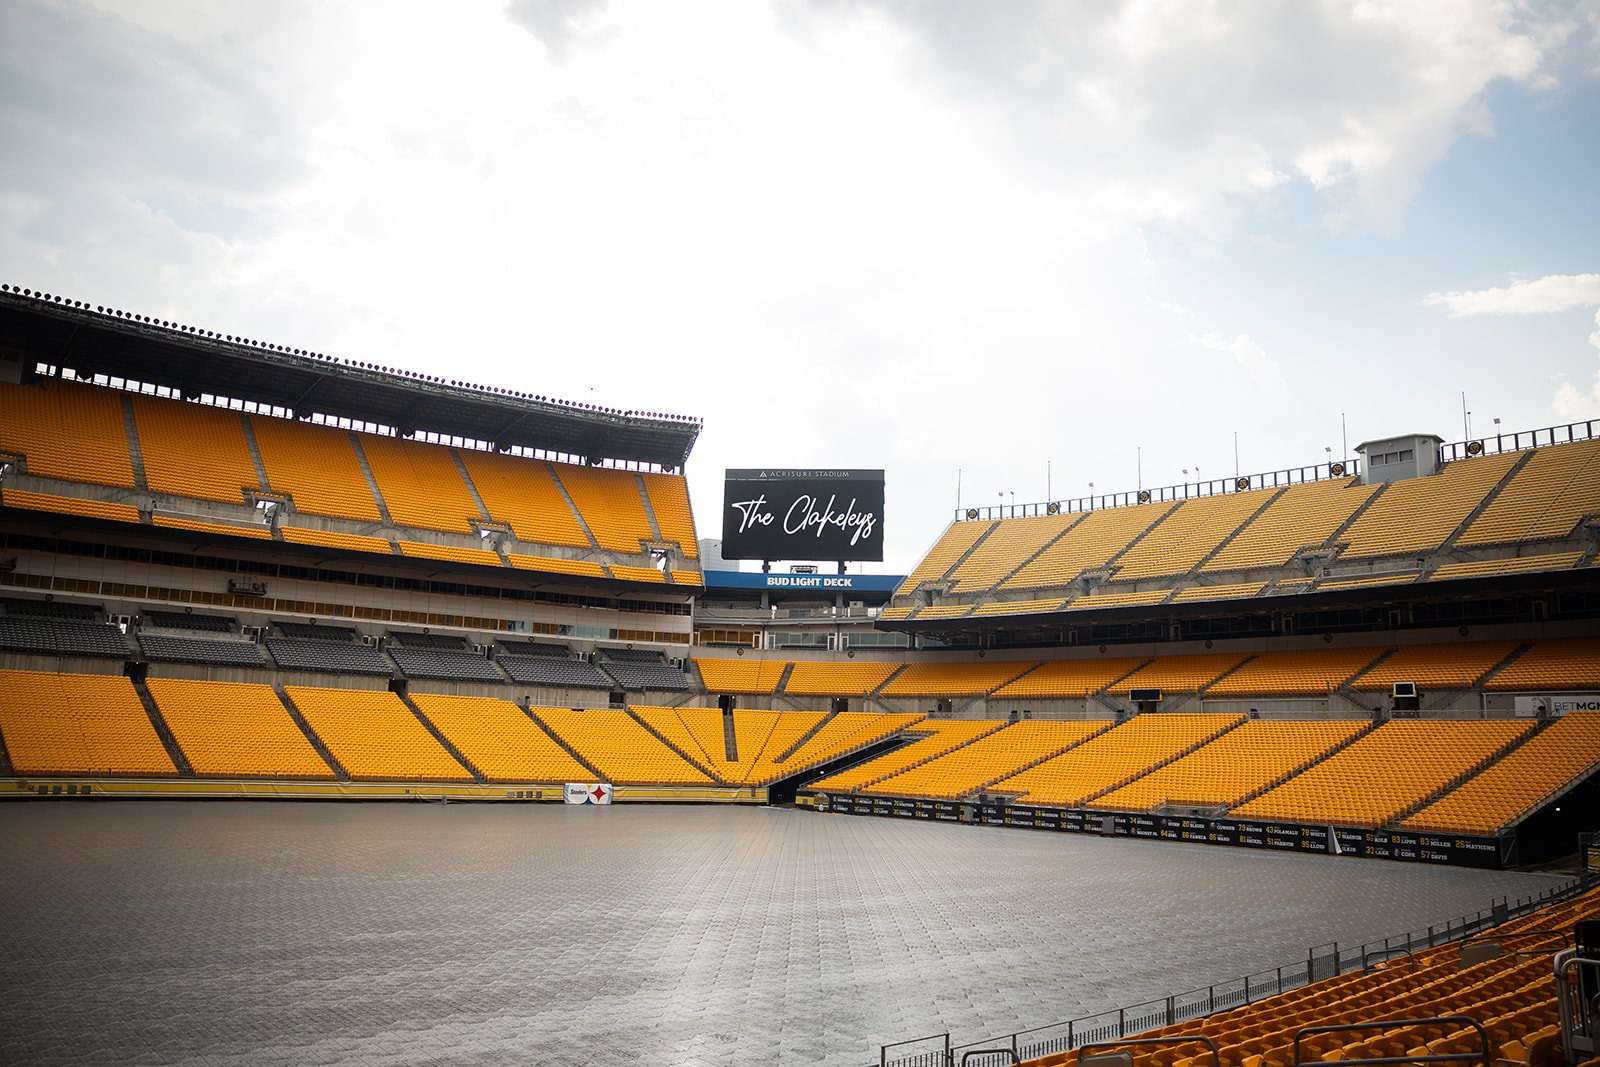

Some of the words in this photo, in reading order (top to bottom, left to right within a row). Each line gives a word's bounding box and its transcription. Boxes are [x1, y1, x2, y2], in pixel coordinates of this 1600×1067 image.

[769, 470, 813, 478] ACRISURE
[815, 470, 850, 478] STADIUM
[731, 494, 775, 534] The
[783, 494, 877, 546] Clakeleys
[767, 577, 790, 586] BUD
[790, 577, 821, 587] LIGHT
[823, 578, 852, 588] DECK
[1554, 702, 1600, 710] BETMG
[1182, 820, 1190, 828] 20
[1238, 824, 1246, 832] 79
[1265, 826, 1274, 834] 43
[1301, 828, 1310, 836] 78
[1266, 837, 1274, 846] 51
[1391, 835, 1401, 843] 83
[1419, 837, 1430, 846] 83
[1430, 840, 1452, 848] MILLER
[1455, 839, 1465, 849] 25
[1465, 844, 1496, 852] MATHEWS
[1420, 850, 1431, 859] 57
